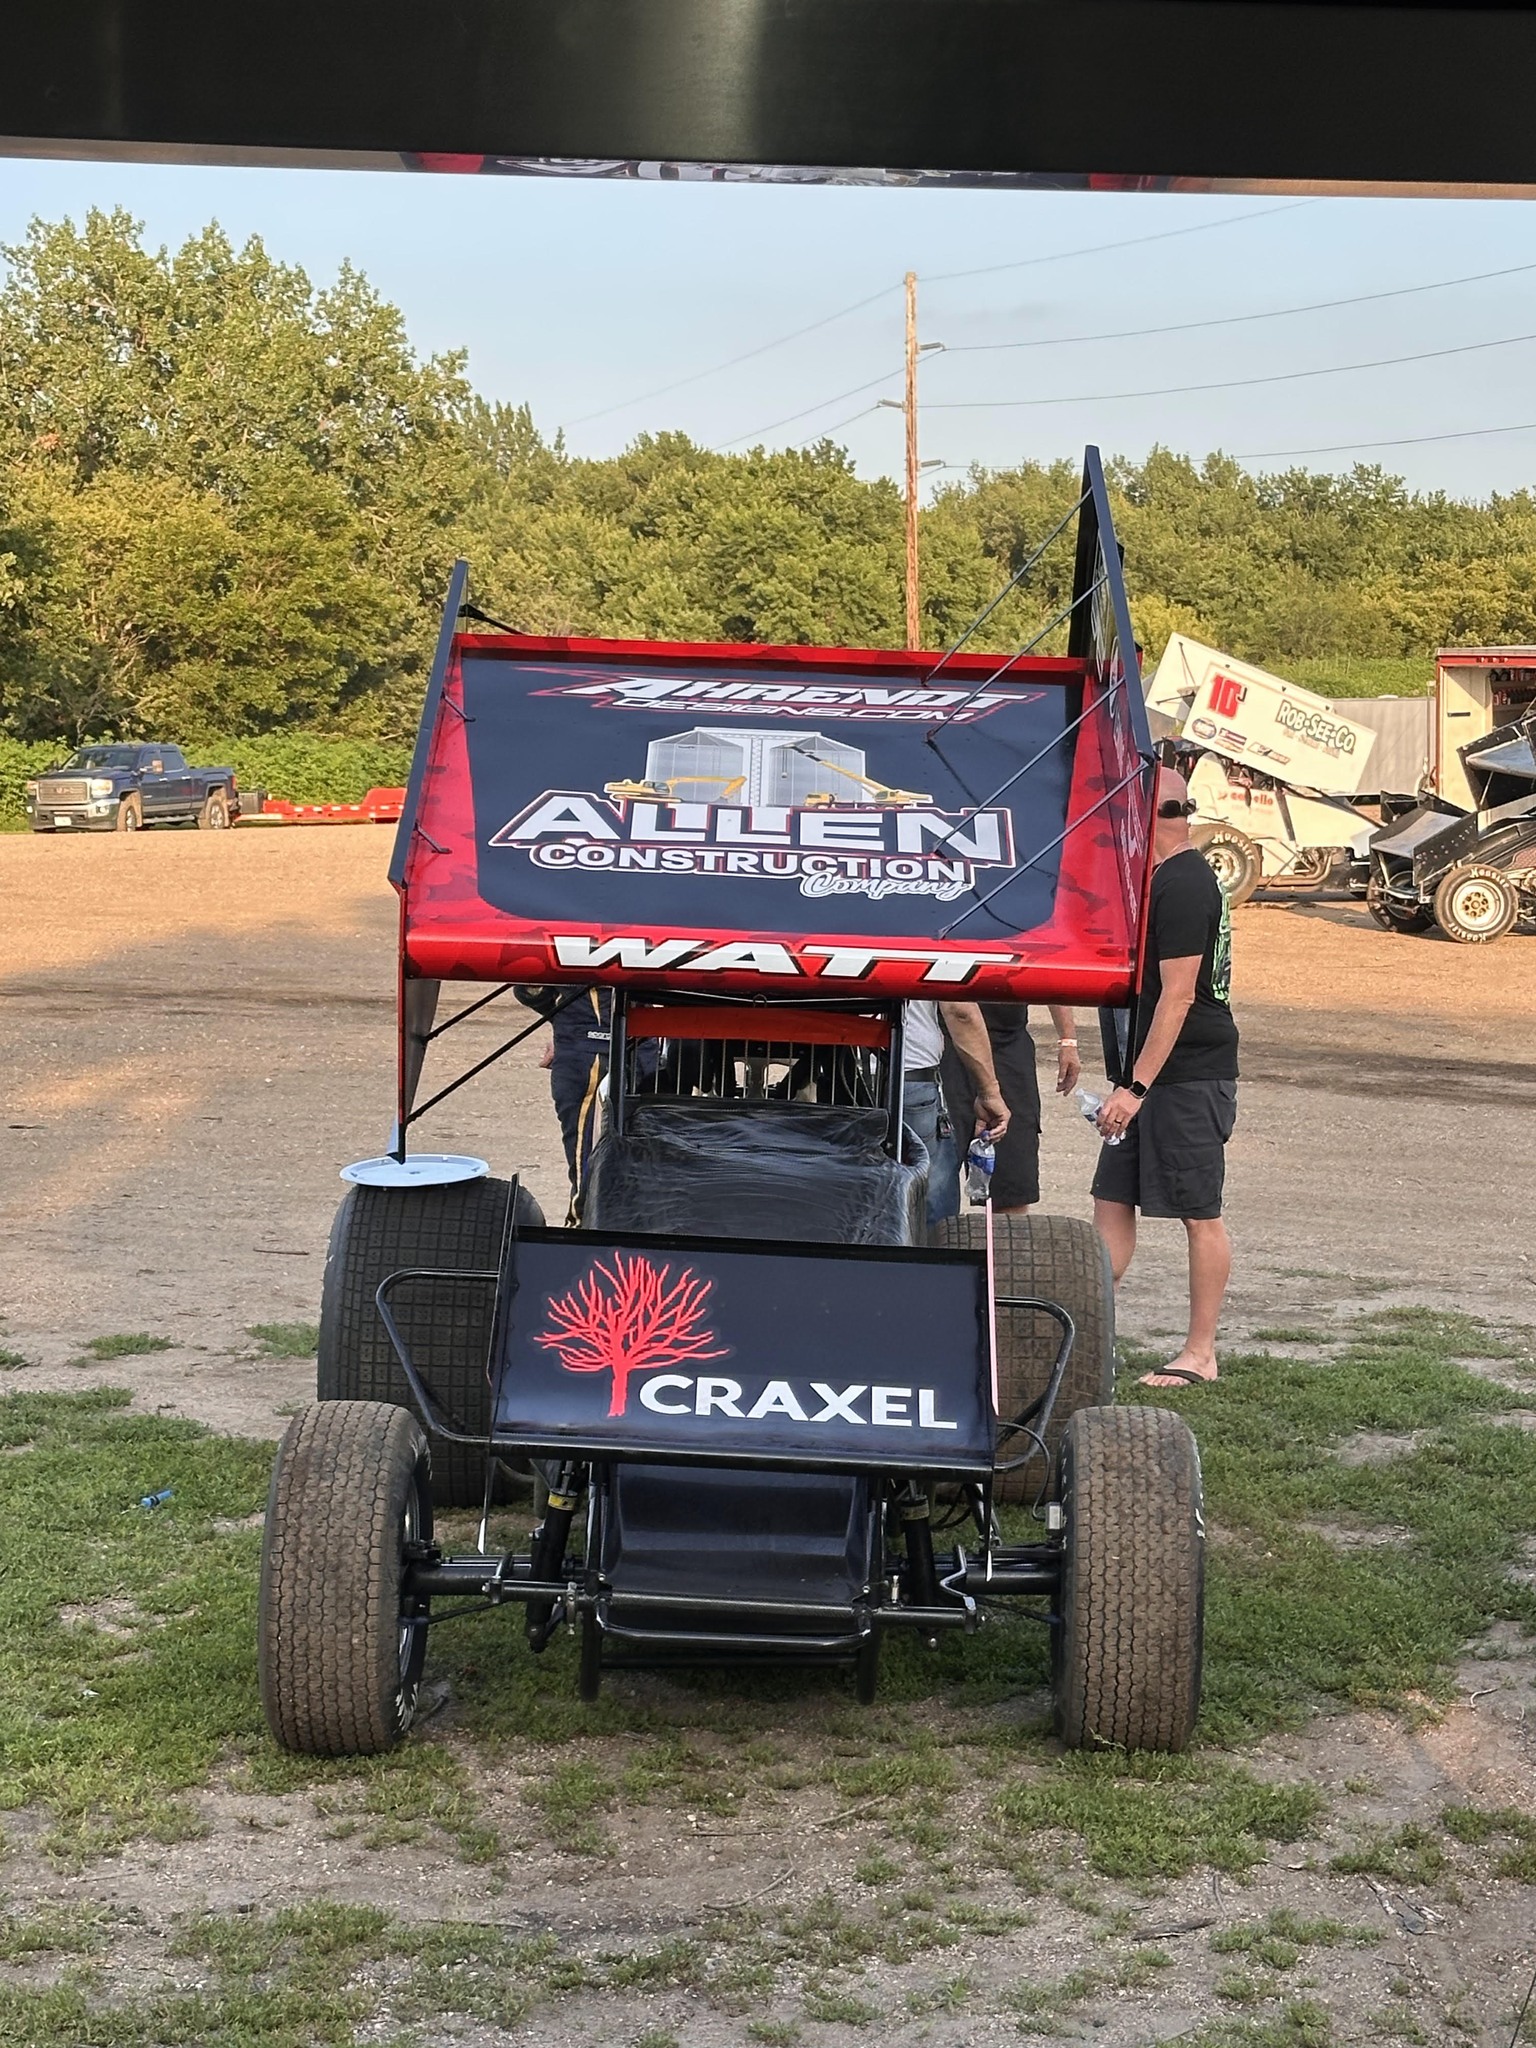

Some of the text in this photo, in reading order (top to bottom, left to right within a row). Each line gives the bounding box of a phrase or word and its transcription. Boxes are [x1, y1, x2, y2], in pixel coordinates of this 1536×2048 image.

[561, 676, 1028, 709] AHRENDT
[612, 697, 975, 721] DESIGNS.COM
[507, 795, 1002, 862] ALLEN
[539, 844, 965, 881] CONSTRUCTION
[802, 872, 973, 899] Company
[553, 935, 1018, 982] WATT
[638, 1373, 959, 1430] CRAXEL
